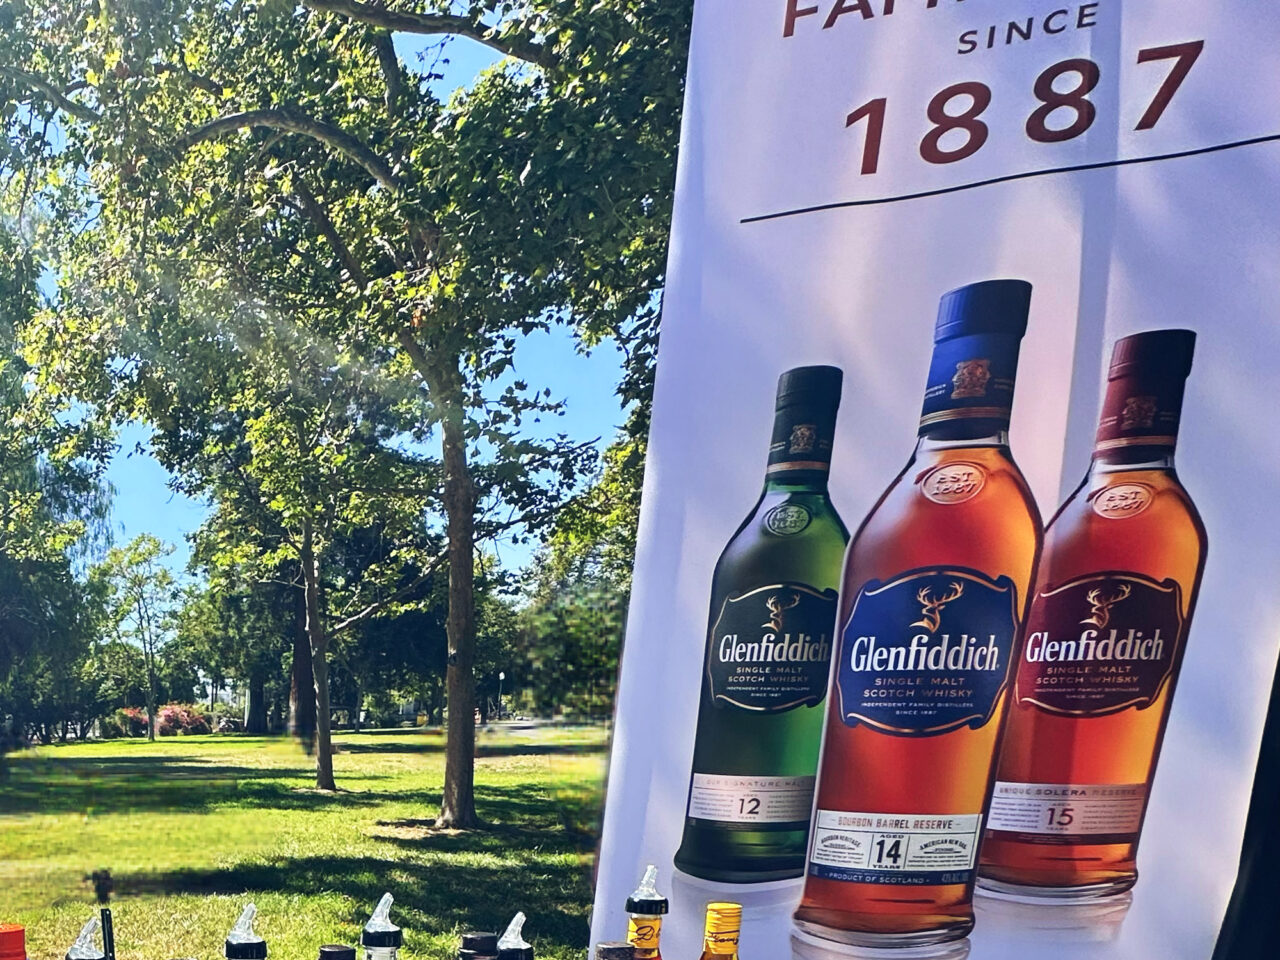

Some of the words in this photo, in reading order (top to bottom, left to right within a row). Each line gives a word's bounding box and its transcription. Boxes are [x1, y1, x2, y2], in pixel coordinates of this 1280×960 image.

[957, 3, 1099, 55] SINCE
[845, 40, 1205, 176] 1887
[719, 633, 829, 663] Glenfiddich
[851, 634, 1000, 672] Glenfiddich
[1026, 629, 1163, 662] Glenfiddich
[1047, 666, 1092, 674] SINGLE
[874, 678, 921, 686] SINGLE
[931, 678, 965, 686] MALT
[1036, 676, 1083, 684] SCOTCH
[864, 690, 915, 698] SCOTCH
[1035, 788, 1087, 796] SOLERA
[738, 798, 761, 815] 12
[838, 816, 873, 827] BOURBON
[876, 818, 910, 829] BARREL
[913, 820, 954, 830] RESERVE
[1047, 808, 1075, 826] 15
[876, 840, 901, 864] 14
[829, 872, 863, 881] PRODUCT
